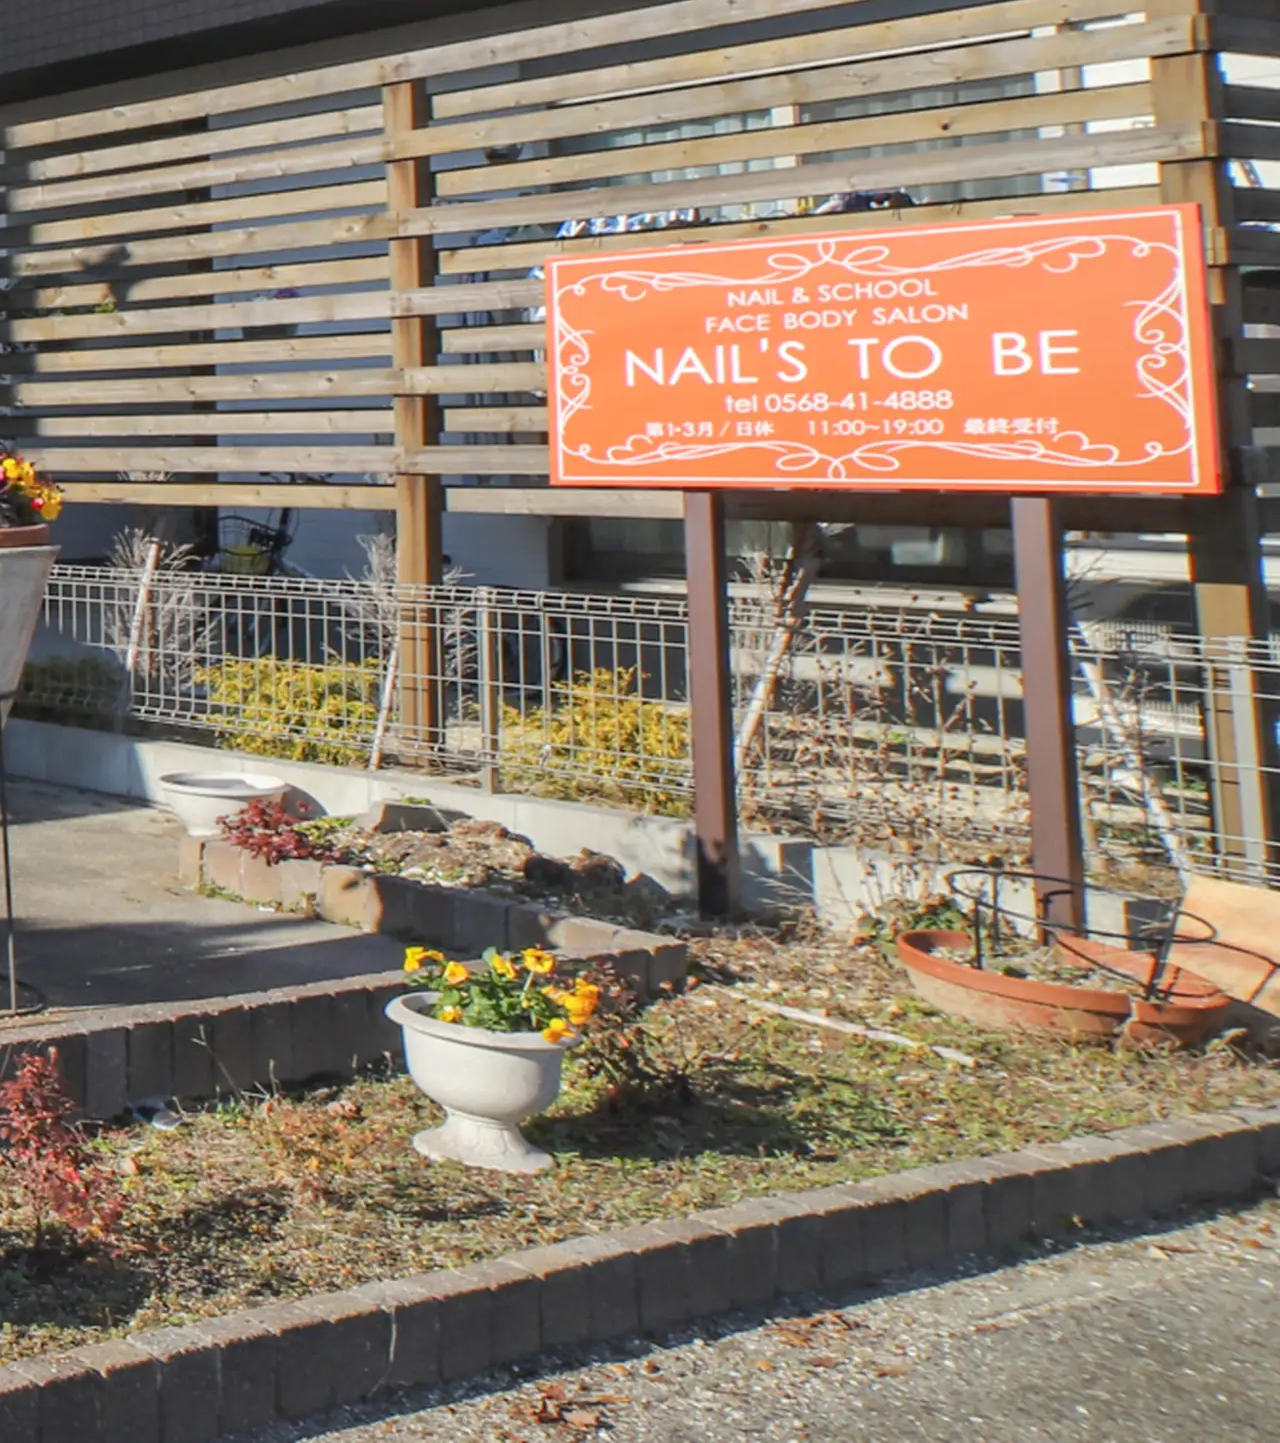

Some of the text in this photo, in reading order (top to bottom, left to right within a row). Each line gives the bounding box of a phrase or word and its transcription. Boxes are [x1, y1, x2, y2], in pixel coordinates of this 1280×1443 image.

[728, 278, 938, 308] NAIL & SCHOOL
[705, 303, 969, 334] FACE BODY SALON
[625, 330, 1081, 387] NAIL'S TO BE
[725, 389, 954, 414] tel 0568-41-4888
